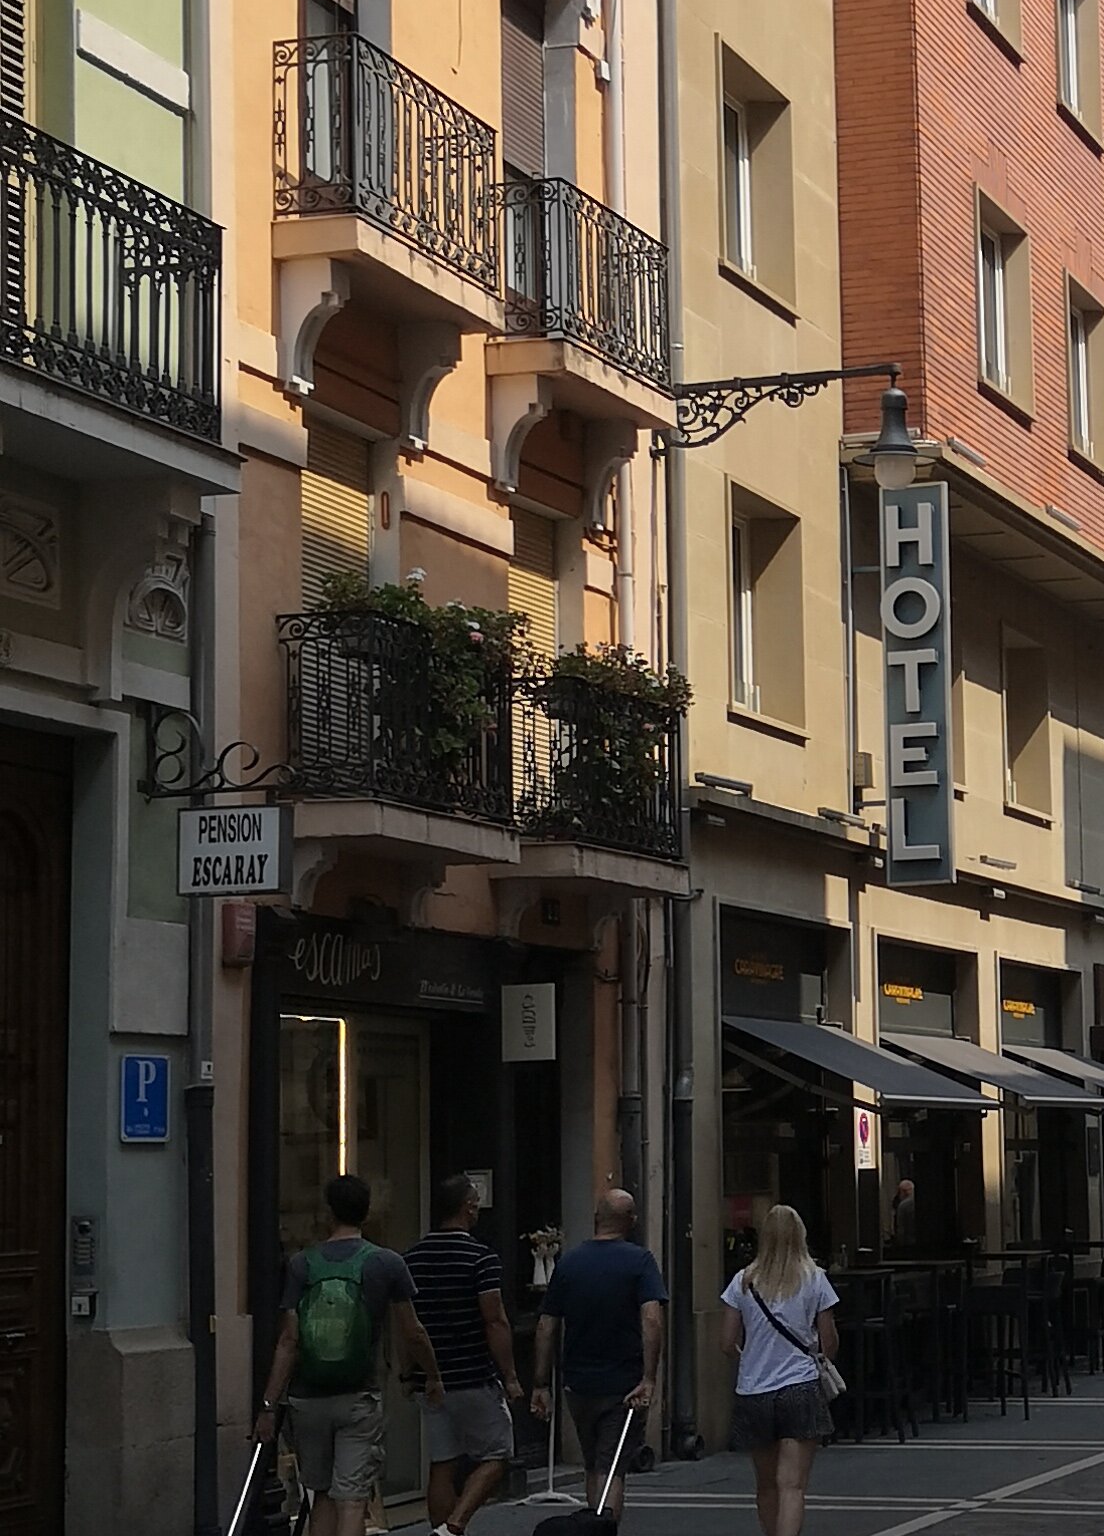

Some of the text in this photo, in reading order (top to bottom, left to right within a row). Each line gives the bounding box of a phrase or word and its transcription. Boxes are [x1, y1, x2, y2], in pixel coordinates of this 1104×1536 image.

[881, 503, 941, 861] HOTEL
[199, 813, 262, 844] PENSION
[192, 854, 268, 887] ESCARAY
[288, 932, 381, 985] escamas
[136, 1060, 157, 1103] P
